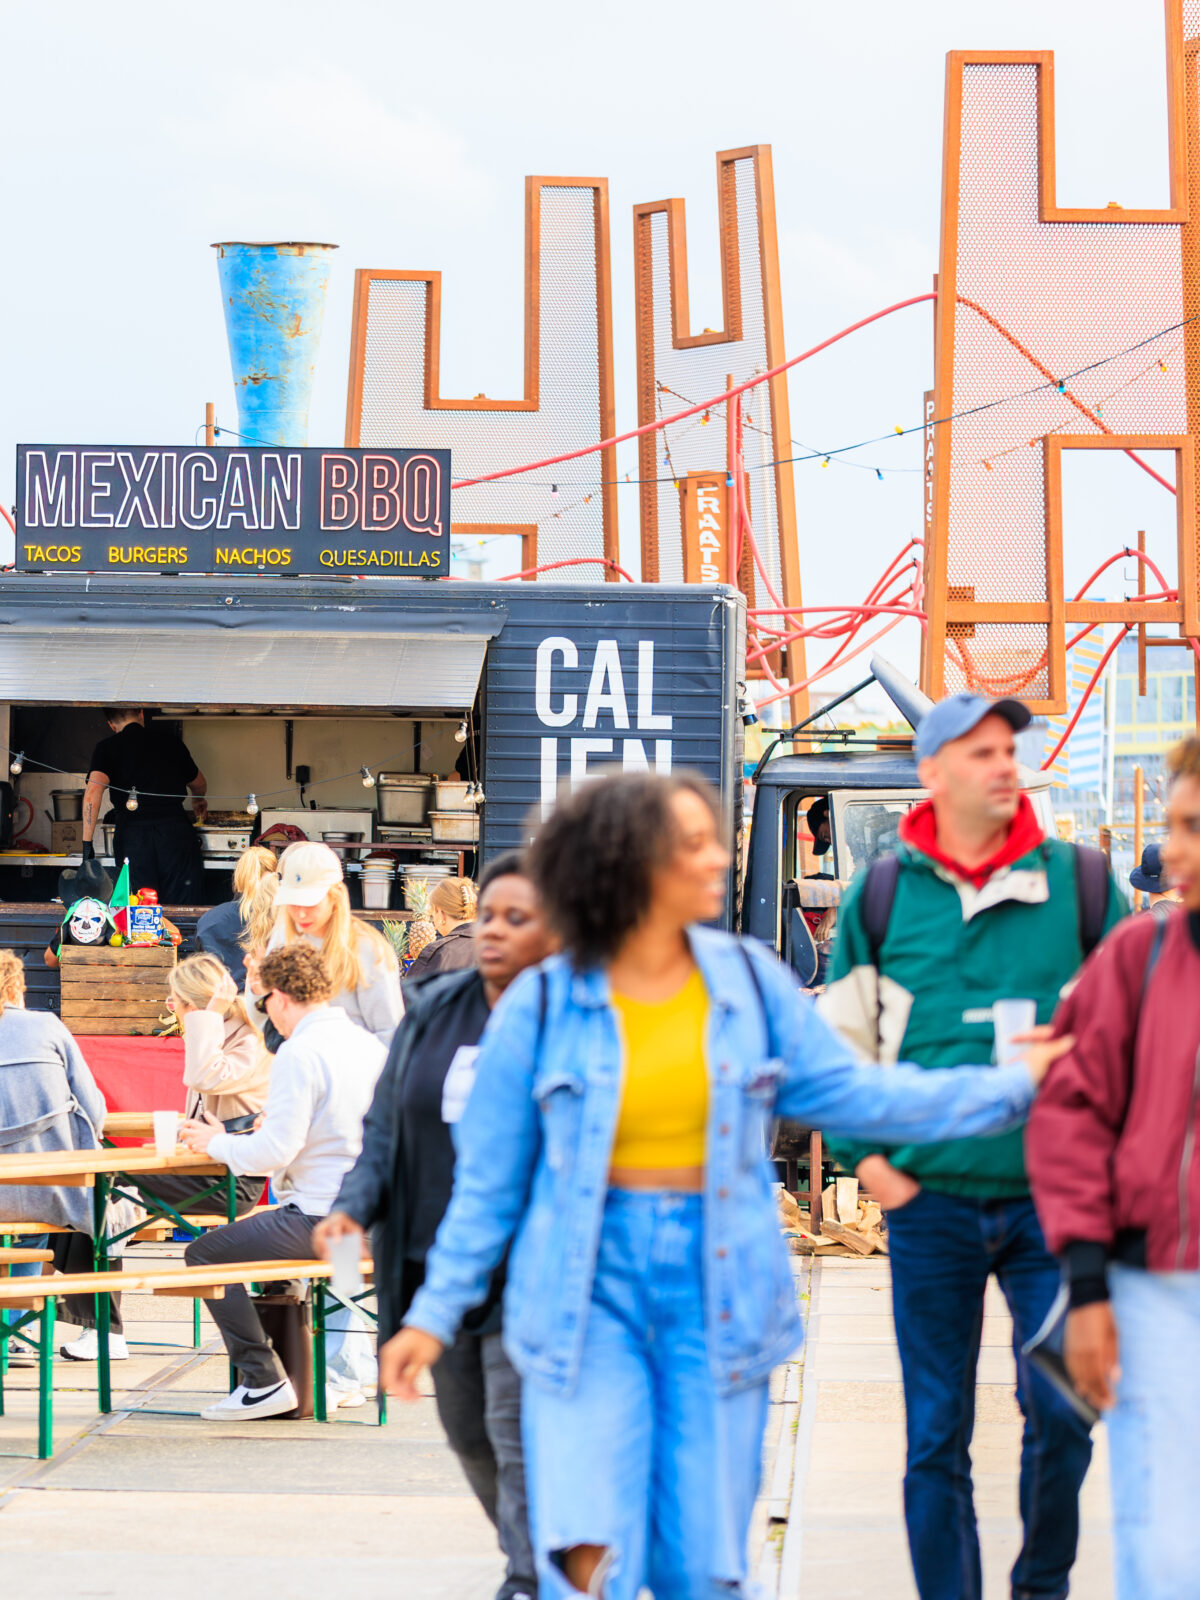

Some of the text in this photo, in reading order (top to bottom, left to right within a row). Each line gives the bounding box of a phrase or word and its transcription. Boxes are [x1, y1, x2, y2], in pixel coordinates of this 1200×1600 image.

[23, 450, 444, 538] MEXICAN BBQ
[23, 544, 441, 569] TACOS BURGERS NACHOS QUESADILLAS
[535, 636, 673, 730] CAL
